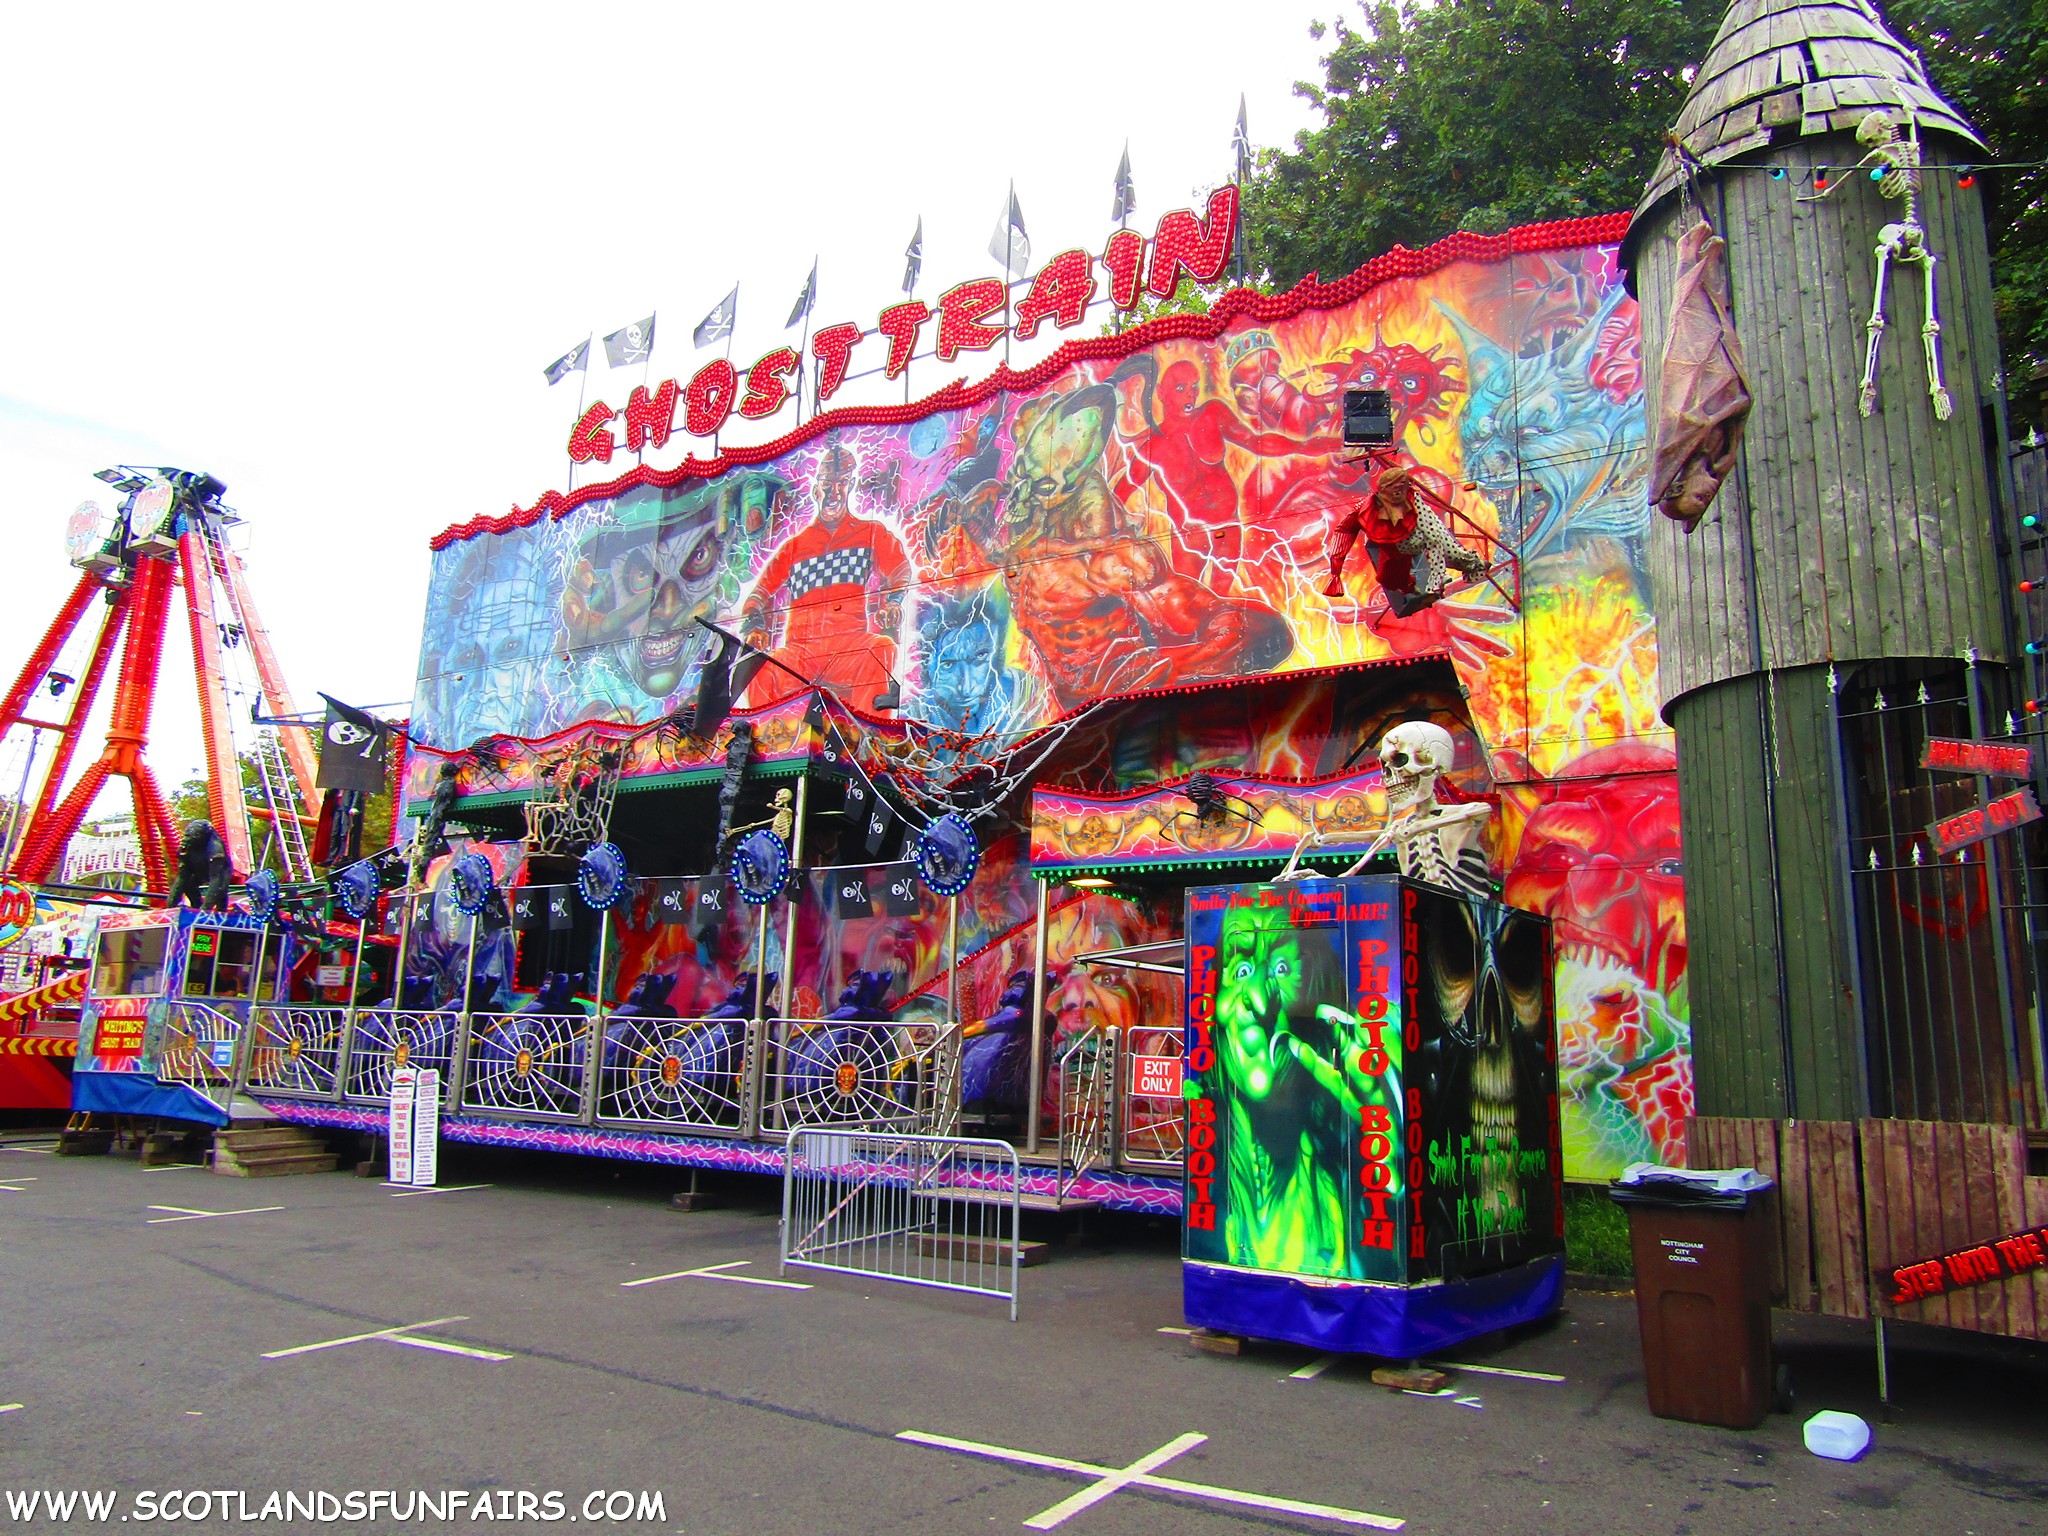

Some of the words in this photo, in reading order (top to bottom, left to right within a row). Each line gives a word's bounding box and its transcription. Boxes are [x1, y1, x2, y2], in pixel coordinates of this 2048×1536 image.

[567, 323, 859, 464] GHOST
[879, 185, 1238, 379] TRAIN
[1928, 740, 2030, 779] WARNING
[1937, 809, 1985, 846] KEEP
[1987, 792, 2030, 826] OUT
[1190, 894, 1227, 911] Smile
[1230, 893, 1254, 908] For
[1259, 891, 1284, 907] The
[1288, 890, 1343, 905] Camera
[1303, 909, 1331, 927] you
[1335, 902, 1389, 922] DARE!
[192, 943, 212, 952] HERE
[1403, 889, 1420, 1053] PHOTO
[1189, 945, 1216, 1072] PHOTO
[1357, 939, 1390, 1077] PHOTO
[1104, 1038, 1114, 1092] GHOST
[1141, 1077, 1174, 1092] ONLY
[1144, 1061, 1171, 1076] EXIT
[743, 1082, 752, 1128] TRAIN
[1102, 1100, 1112, 1155] TRAIN
[1188, 1098, 1216, 1231] BOOTH
[1359, 1105, 1394, 1250] BOOTH
[1406, 1088, 1425, 1258] BOOTH
[1429, 1128, 1458, 1188] Smile
[1460, 1134, 1483, 1186] For
[1485, 1136, 1509, 1186] The
[1511, 1134, 1546, 1178] Camera
[1457, 1189, 1469, 1255] If
[1472, 1197, 1494, 1254] You
[1496, 1188, 1528, 1252] Dare!
[1660, 1240, 1704, 1249] NOTTINGHAM
[1668, 1254, 1698, 1264] COUNCIL
[1892, 1259, 1945, 1303] STEP
[1944, 1246, 2001, 1286] INTO
[1995, 1233, 2047, 1274] THE
